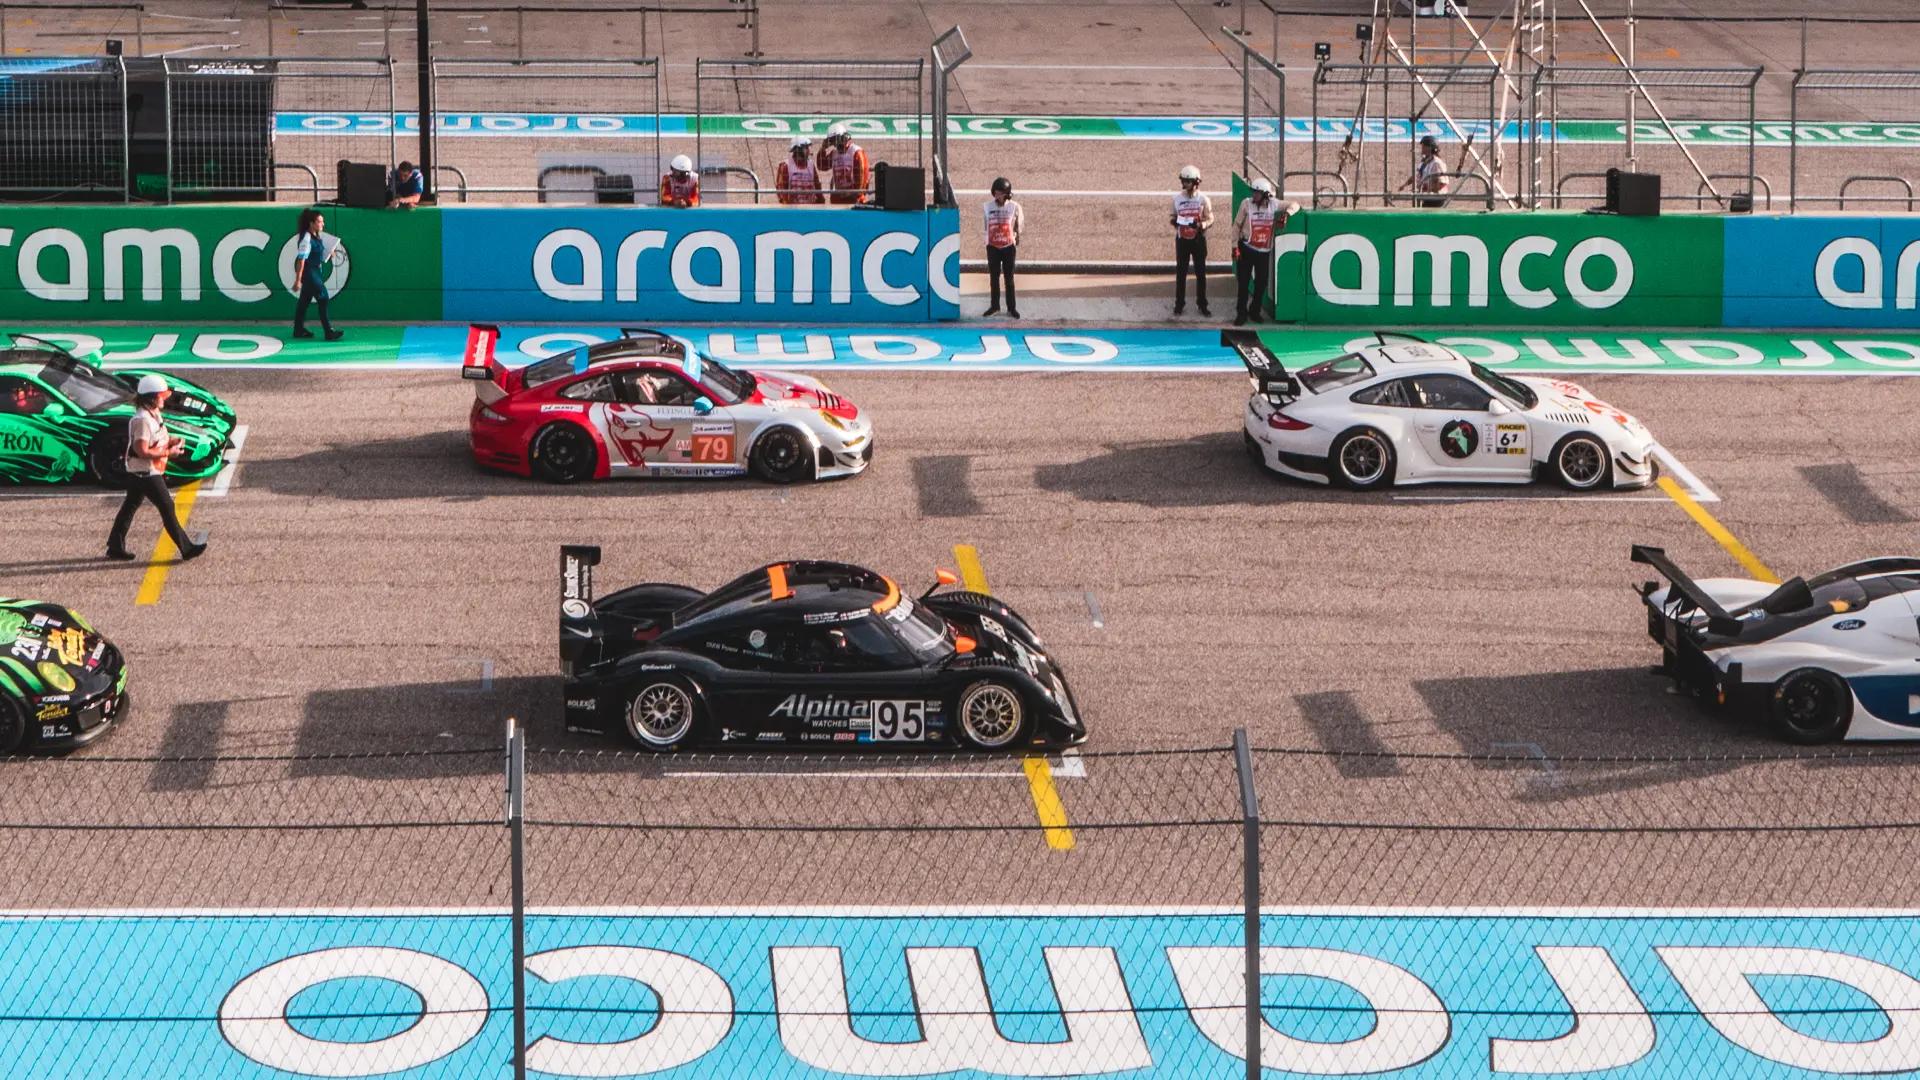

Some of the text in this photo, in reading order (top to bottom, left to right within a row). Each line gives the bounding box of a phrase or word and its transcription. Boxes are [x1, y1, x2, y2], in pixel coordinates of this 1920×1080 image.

[301, 115, 624, 131] aramco
[741, 117, 1062, 135] aramco
[0, 228, 350, 302] amco
[698, 437, 728, 460] 79
[1500, 433, 1518, 446] 67
[1839, 621, 1859, 630] Ford
[769, 695, 870, 722] Alpina
[812, 719, 847, 727] WATCHES
[878, 701, 922, 739] 95
